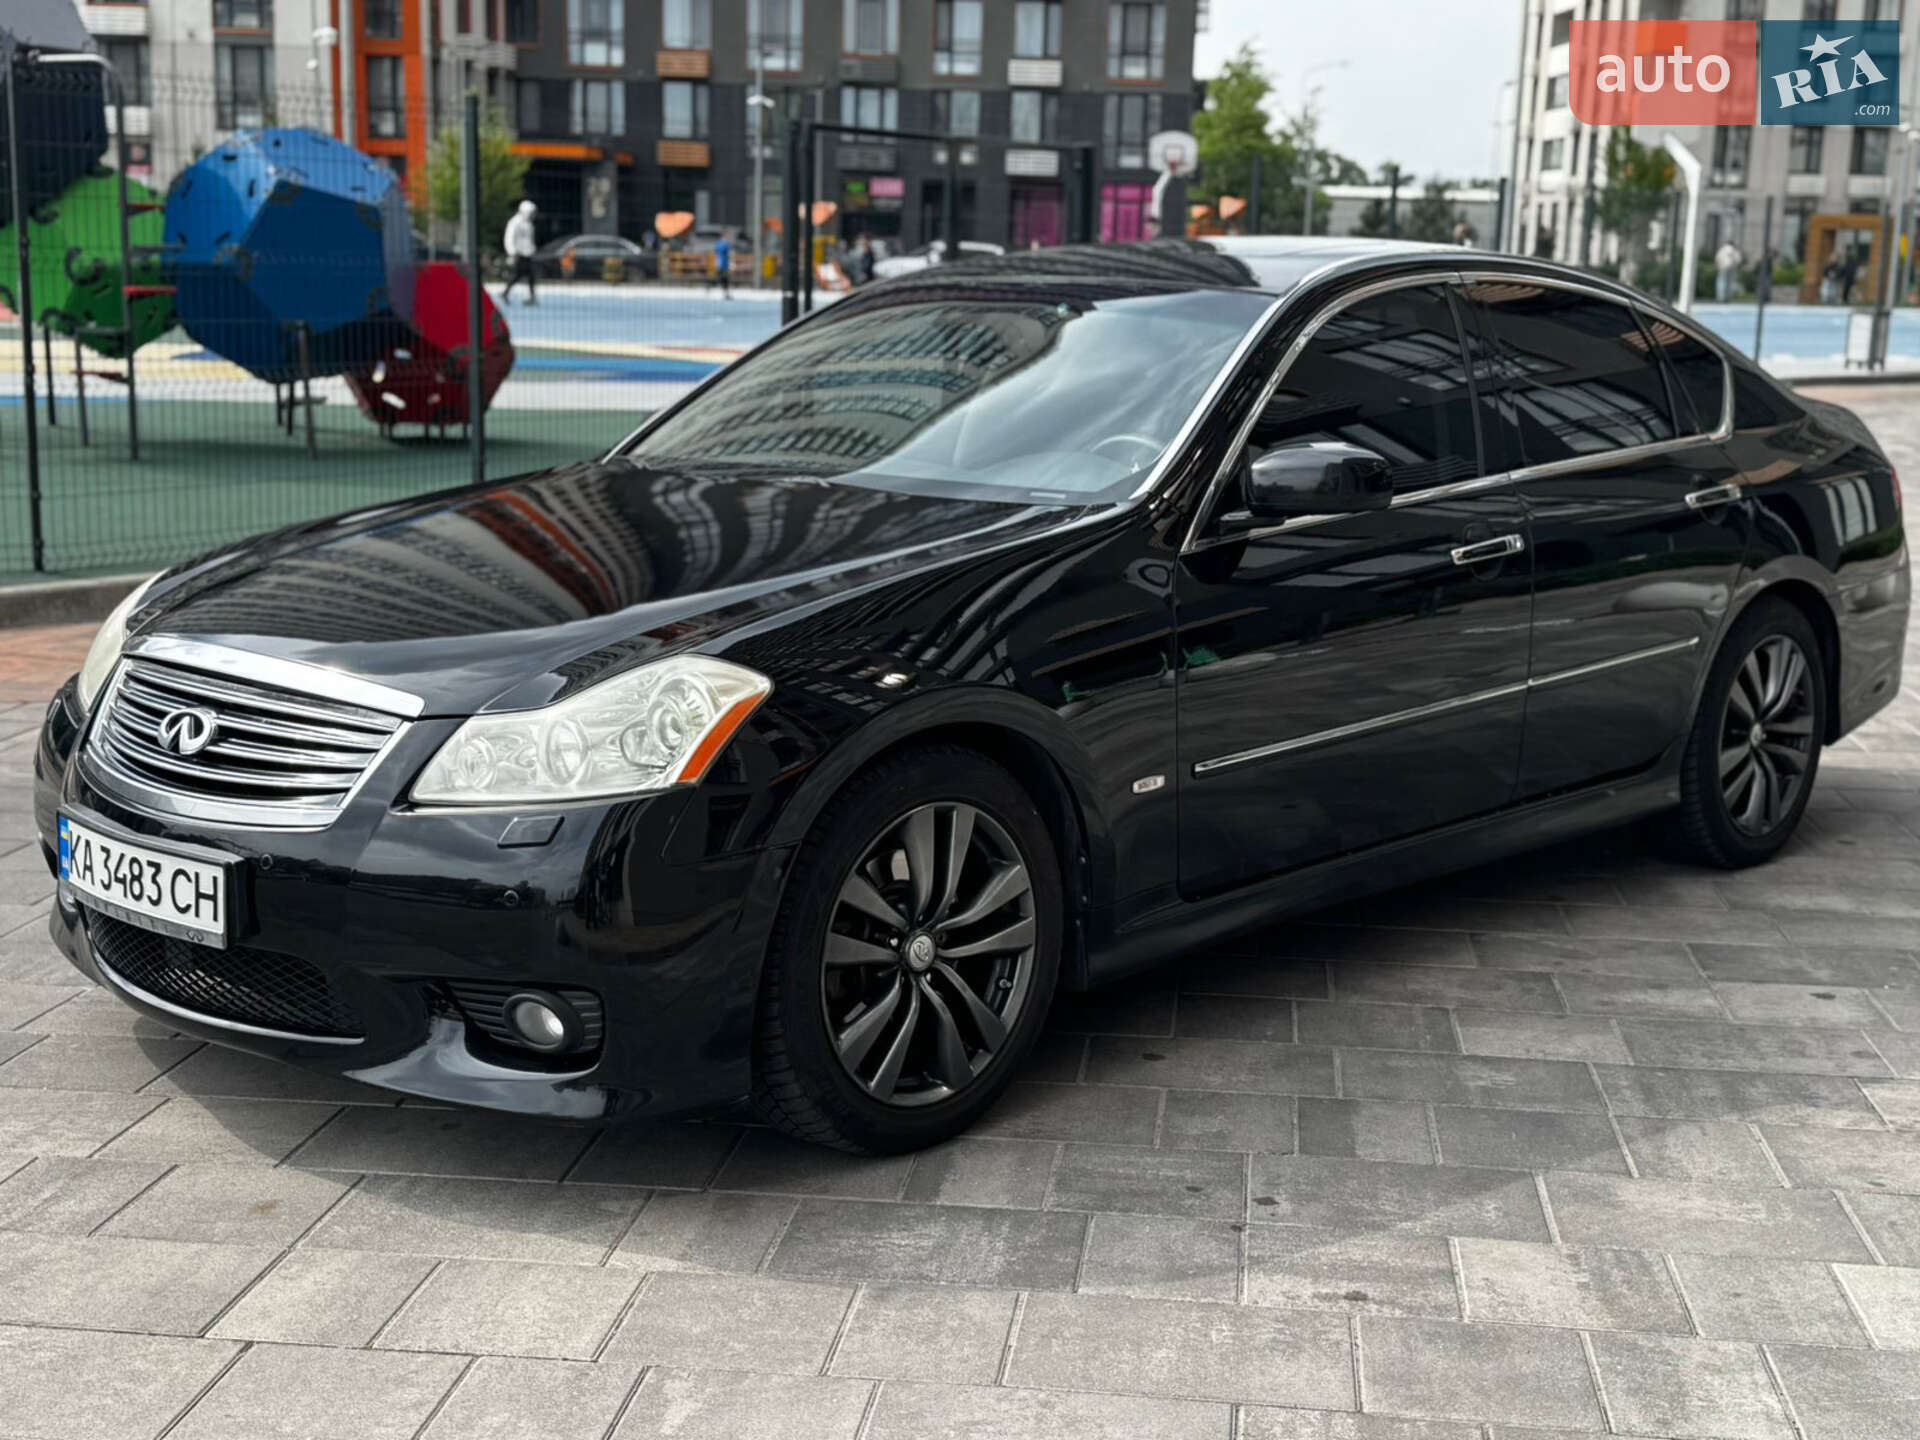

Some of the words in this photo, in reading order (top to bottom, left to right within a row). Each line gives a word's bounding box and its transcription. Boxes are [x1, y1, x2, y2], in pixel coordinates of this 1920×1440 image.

[69, 830, 95, 886] KA
[99, 844, 162, 907] 3483
[170, 868, 219, 922] CH
